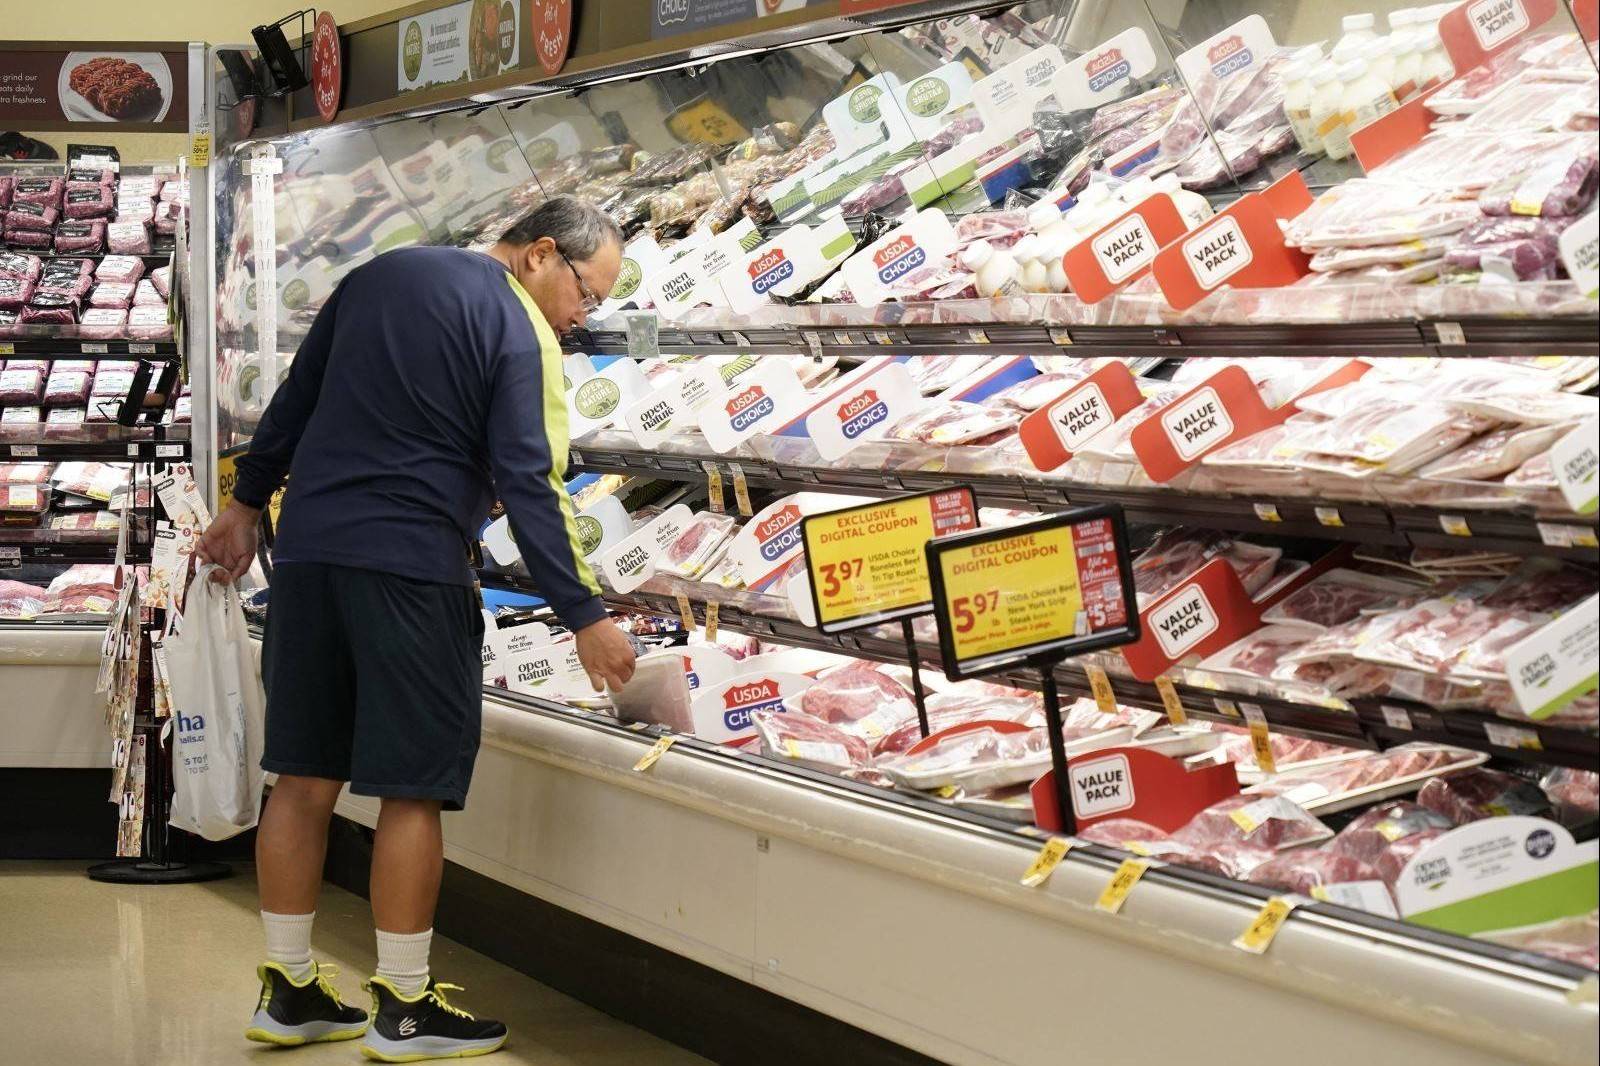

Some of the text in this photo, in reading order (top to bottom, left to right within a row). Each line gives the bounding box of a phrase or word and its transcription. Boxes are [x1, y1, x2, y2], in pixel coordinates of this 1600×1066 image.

[660, 0, 687, 15] CHOICE
[12, 95, 47, 104] freshness
[880, 241, 909, 262] USDA
[1103, 228, 1143, 257] VALUE
[1113, 242, 1145, 266] PACK
[1194, 231, 1236, 262] VALUE
[754, 254, 779, 273] USDA
[883, 250, 923, 281] CHOICE
[1205, 246, 1237, 271] PACK
[662, 272, 689, 293] open
[755, 263, 792, 291] CHOICE
[664, 278, 696, 302] nature
[580, 380, 603, 400] OPEN
[732, 390, 760, 411] USDA
[640, 401, 669, 422] open
[734, 399, 773, 428] CHOICE
[844, 395, 873, 417] USDA
[1059, 397, 1099, 427] VALUE
[642, 405, 674, 431] nature
[846, 405, 887, 436] CHOICE
[1069, 410, 1101, 436] PACK
[1173, 402, 1216, 434] VALUE
[1184, 416, 1218, 443] PACK
[762, 511, 795, 536] USDA
[837, 508, 897, 528] EXCLUSIVE
[765, 526, 802, 557] CHOIC
[820, 516, 918, 544] DIGITAL COUPON
[615, 545, 642, 568] open
[868, 548, 916, 562] USDA Choice
[972, 535, 1036, 558] EXCLUSIVE
[617, 550, 650, 577] nature
[903, 556, 920, 565] Beef
[953, 544, 1058, 575] DIGITAL COUPON
[1059, 583, 1076, 592] Beef
[1008, 605, 1026, 615] New
[1028, 600, 1045, 610] York
[1160, 599, 1202, 631] VALUE
[1171, 613, 1203, 641] PACK
[518, 658, 549, 674] open
[518, 667, 554, 682] nature
[734, 685, 771, 704] USDA
[1078, 770, 1123, 790] VALUE
[1086, 784, 1120, 803] PACK
